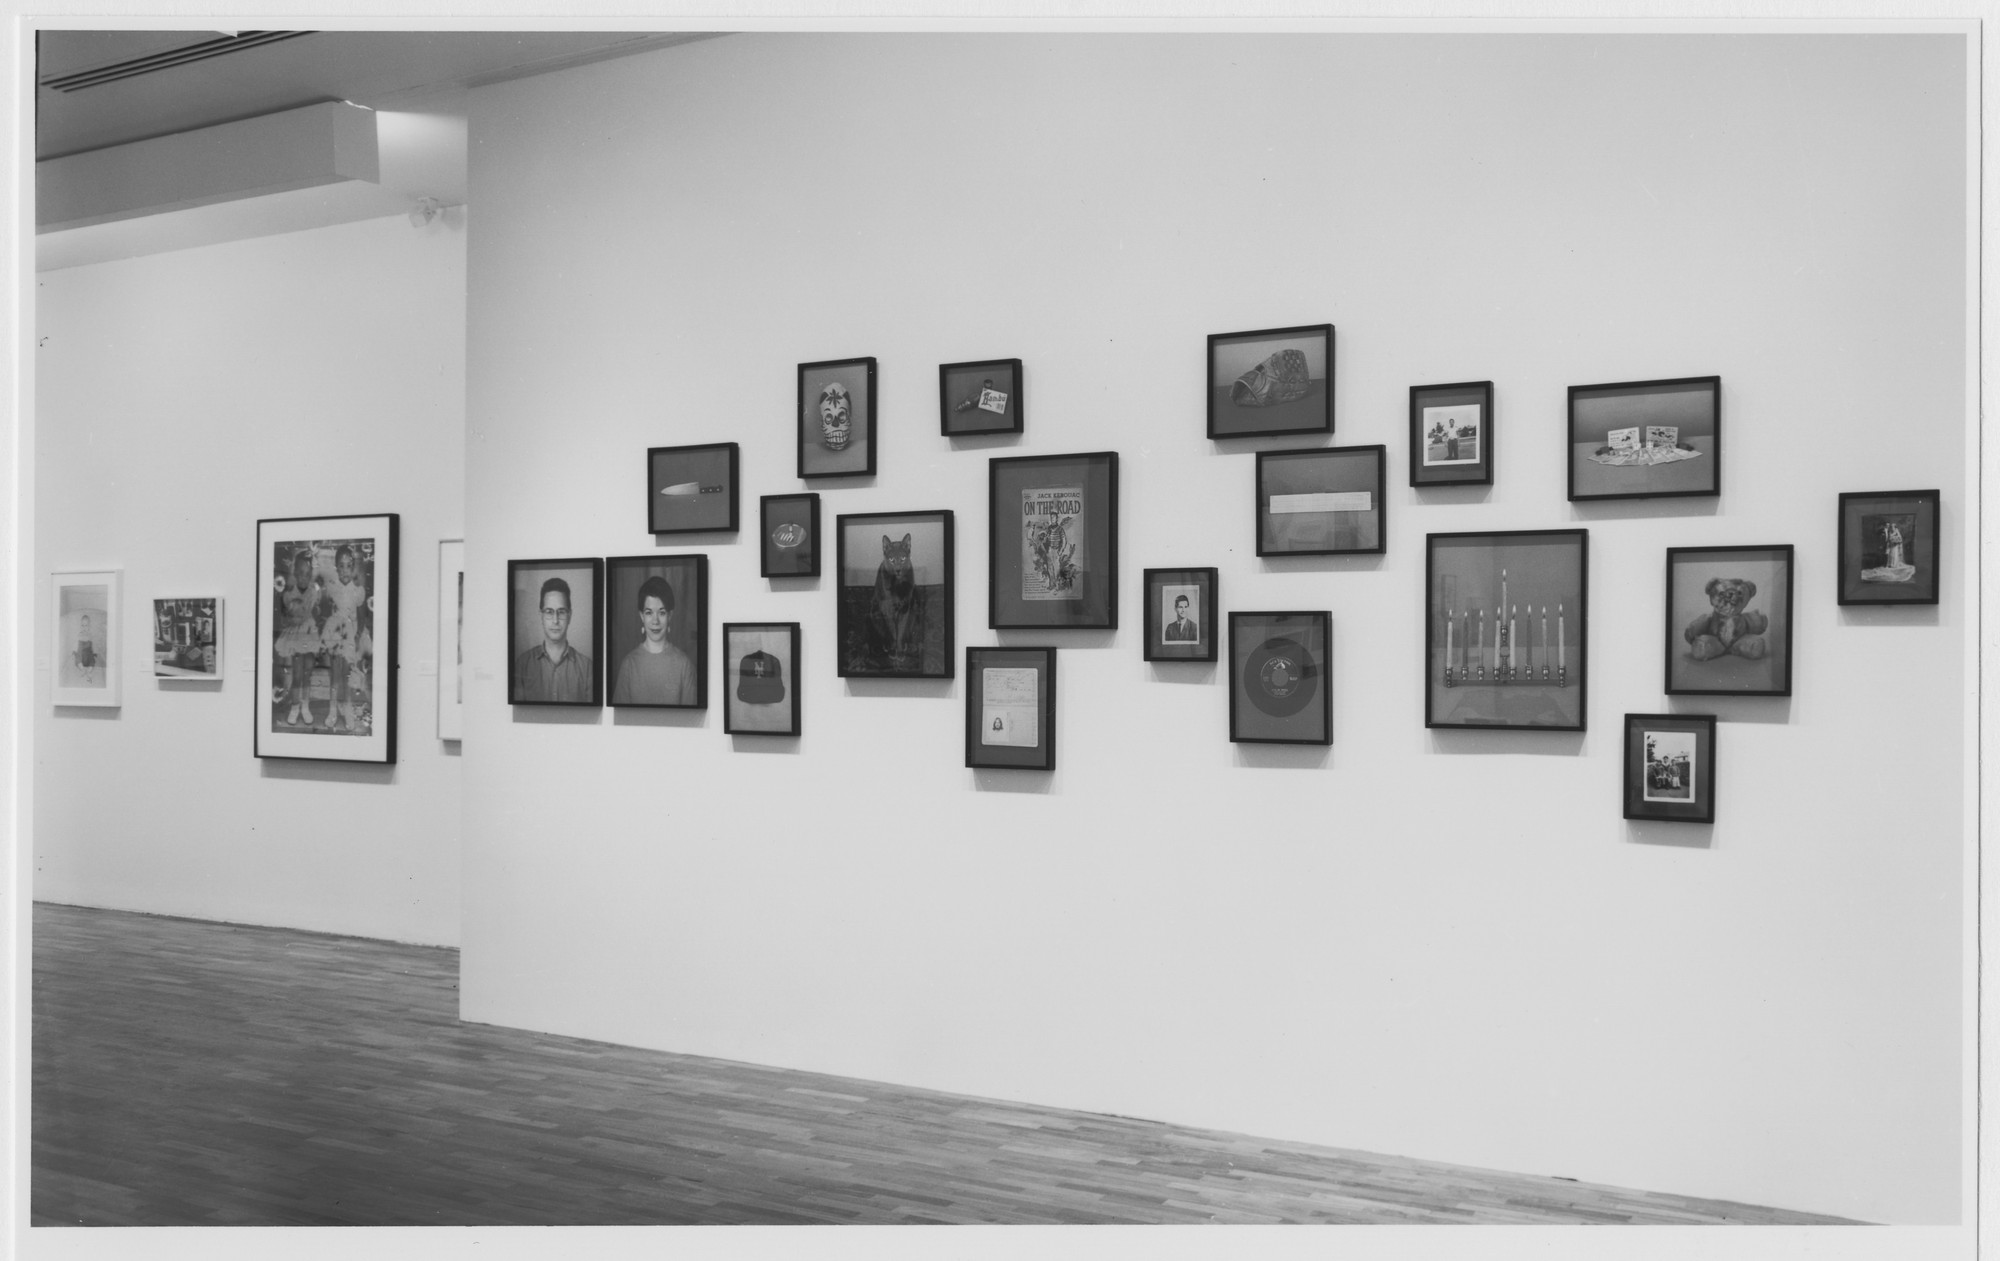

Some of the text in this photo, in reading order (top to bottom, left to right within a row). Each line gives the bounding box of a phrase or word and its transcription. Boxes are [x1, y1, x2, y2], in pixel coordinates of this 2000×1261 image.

[1024, 500, 1081, 516] ON THE ROAD
